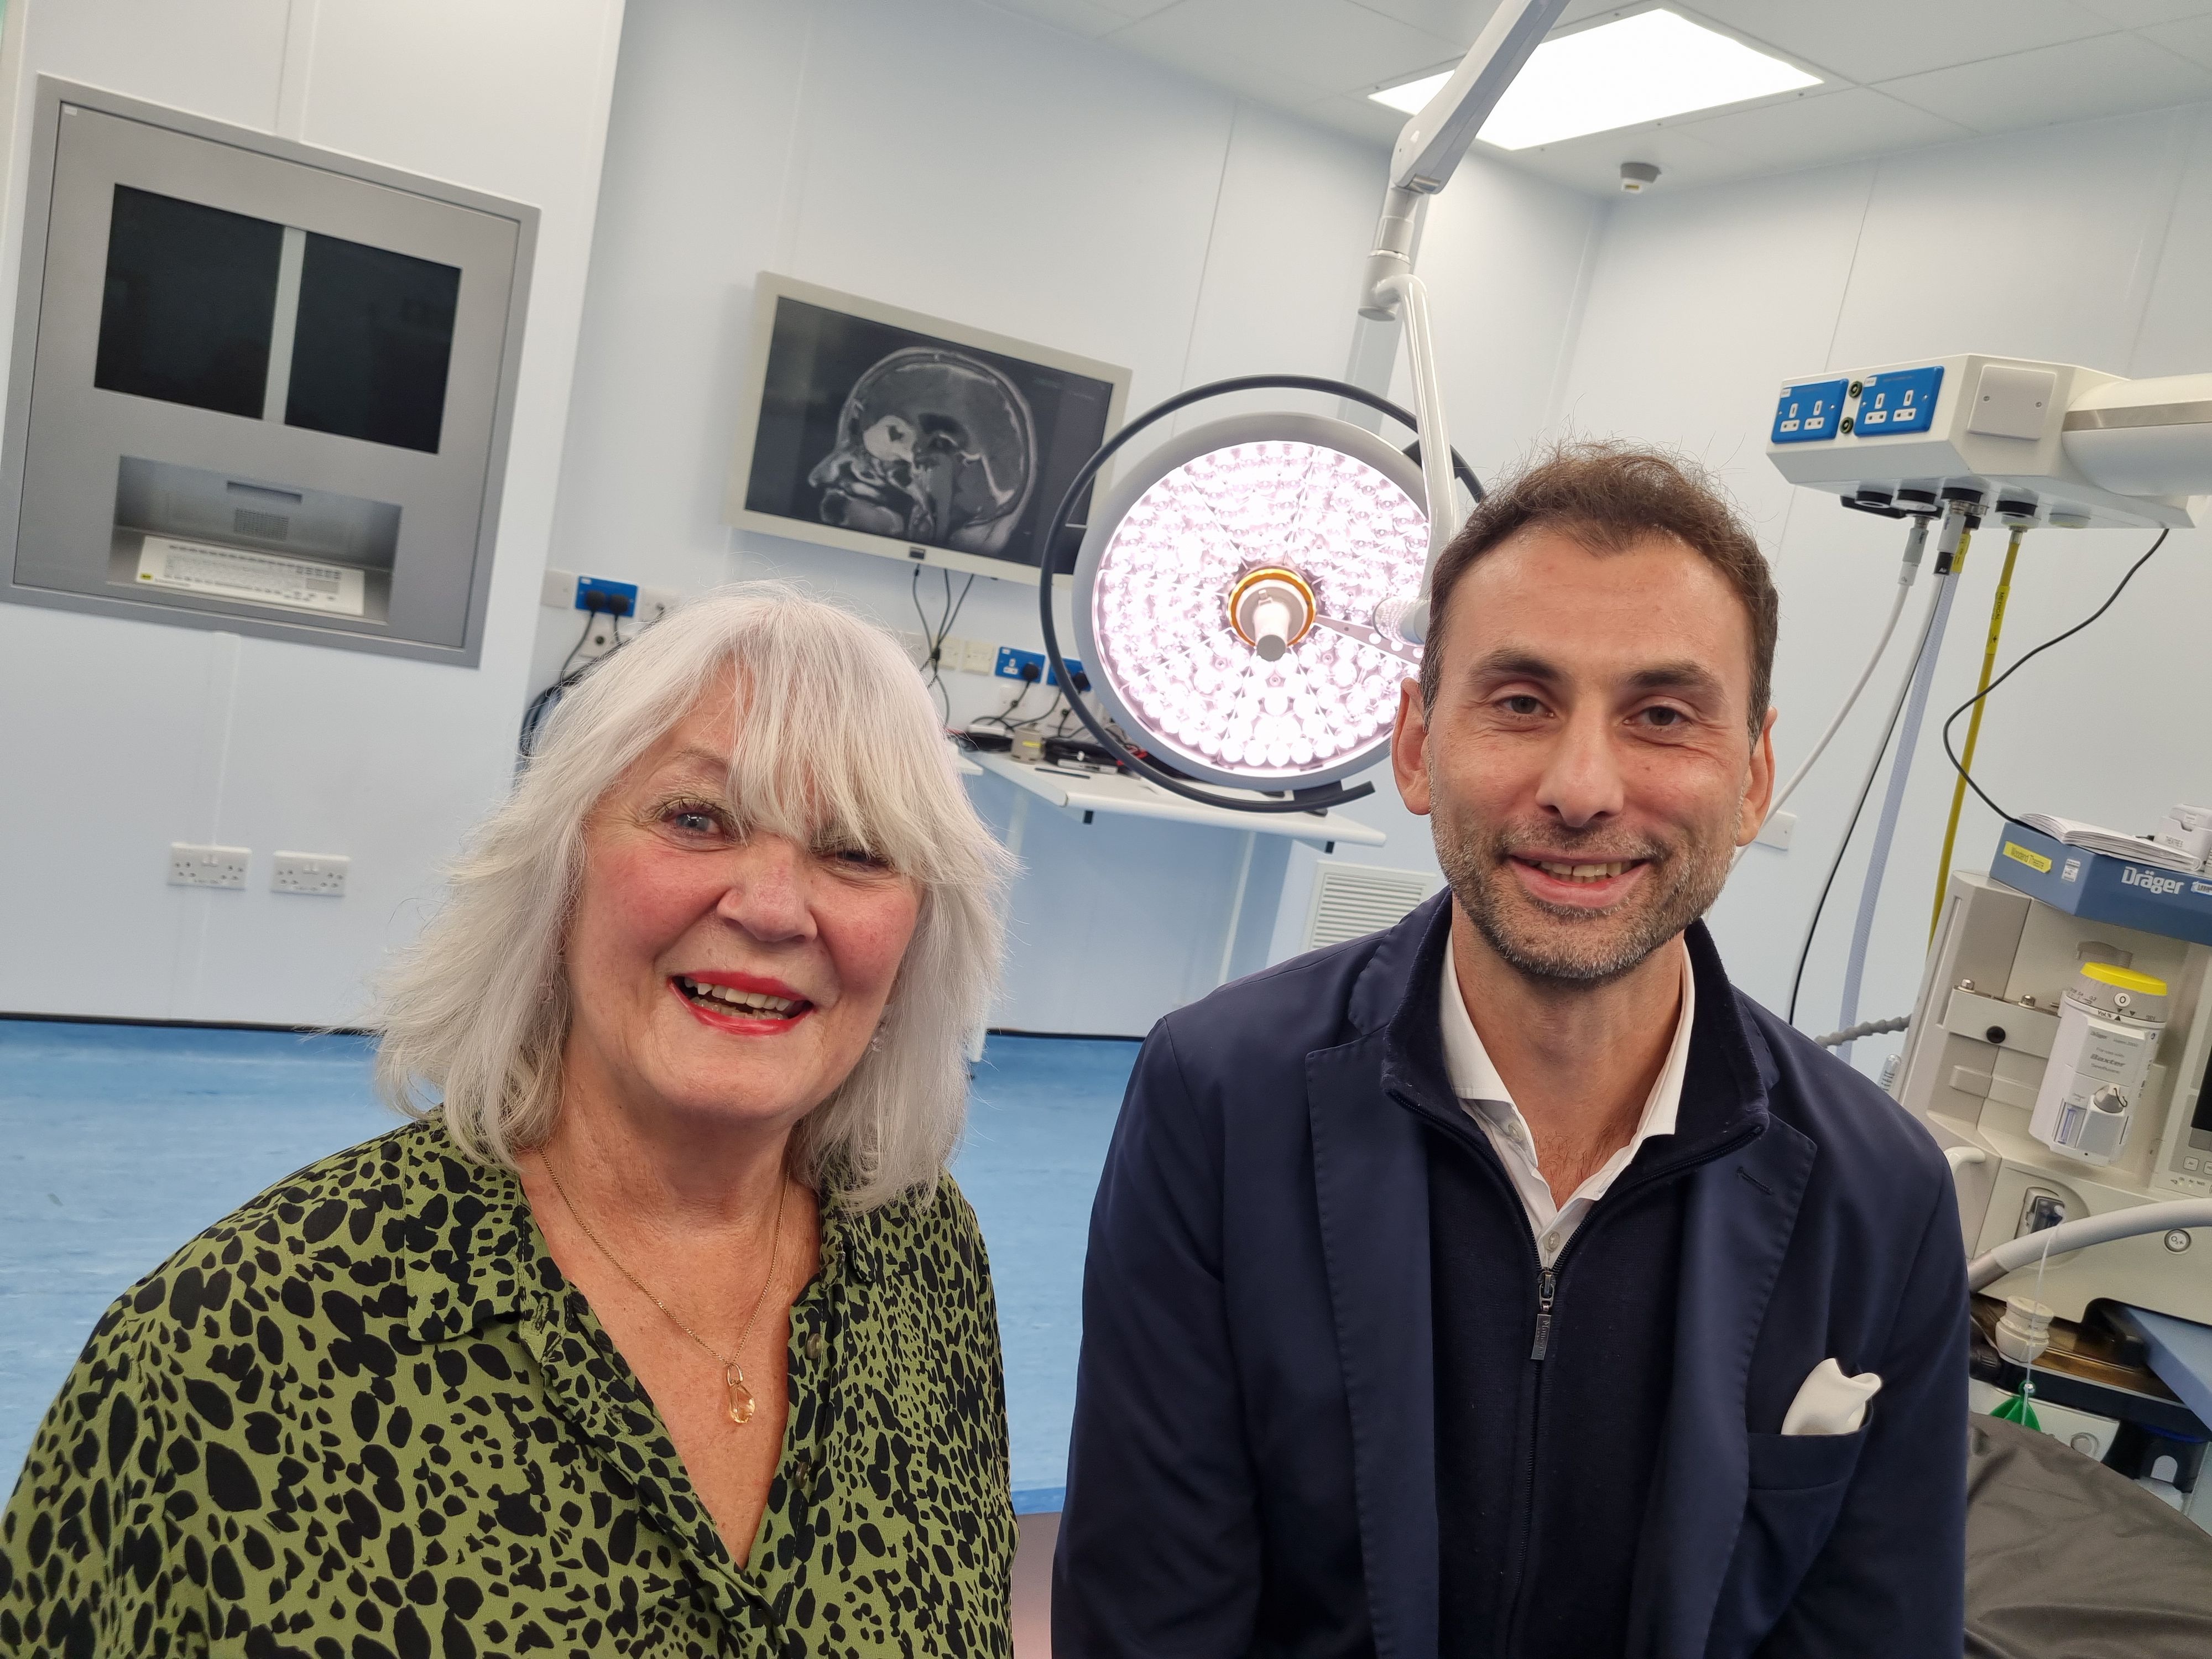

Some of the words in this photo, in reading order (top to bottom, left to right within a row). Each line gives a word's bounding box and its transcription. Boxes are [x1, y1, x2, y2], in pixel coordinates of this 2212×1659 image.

[1995, 592, 2004, 620] MEDICAL
[2121, 866, 2185, 894] Dräger
[2090, 1054, 2125, 1067] Baxter
